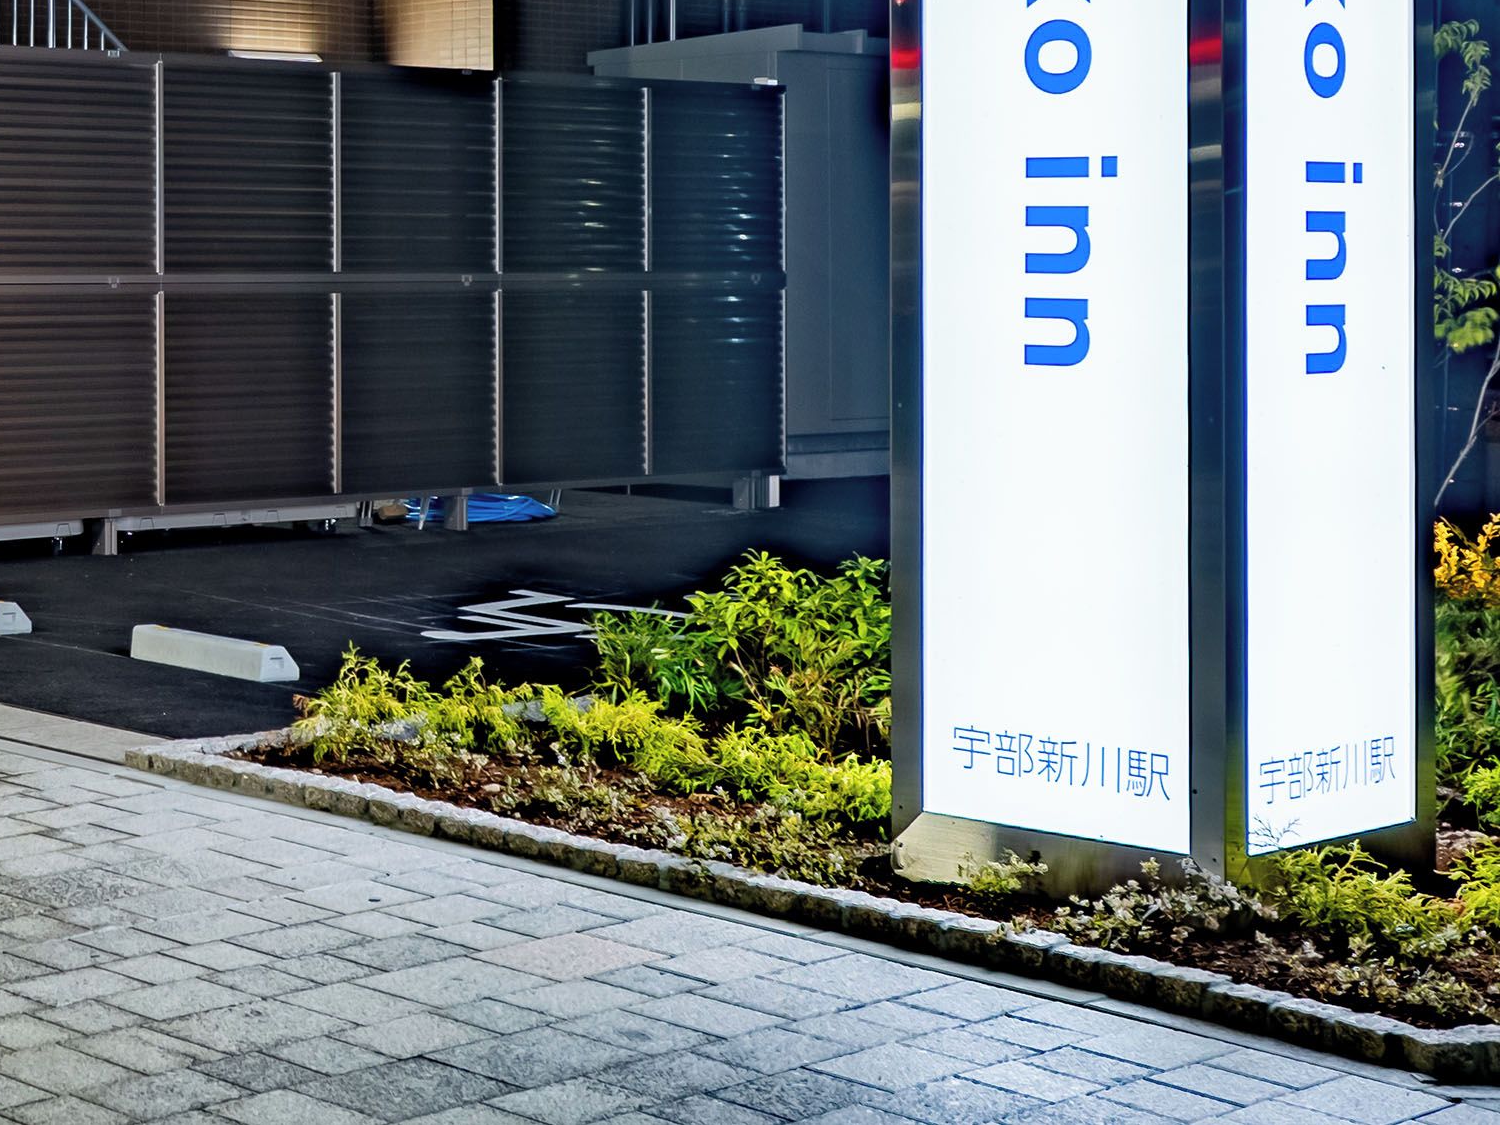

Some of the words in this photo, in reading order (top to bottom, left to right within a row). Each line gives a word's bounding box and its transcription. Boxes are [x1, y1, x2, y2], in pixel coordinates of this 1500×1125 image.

[1023, 155, 1119, 367] inn
[1305, 160, 1364, 376] inn
[952, 725, 1171, 802] 宇部新川駅
[1258, 735, 1397, 806] 宇部新川駅
